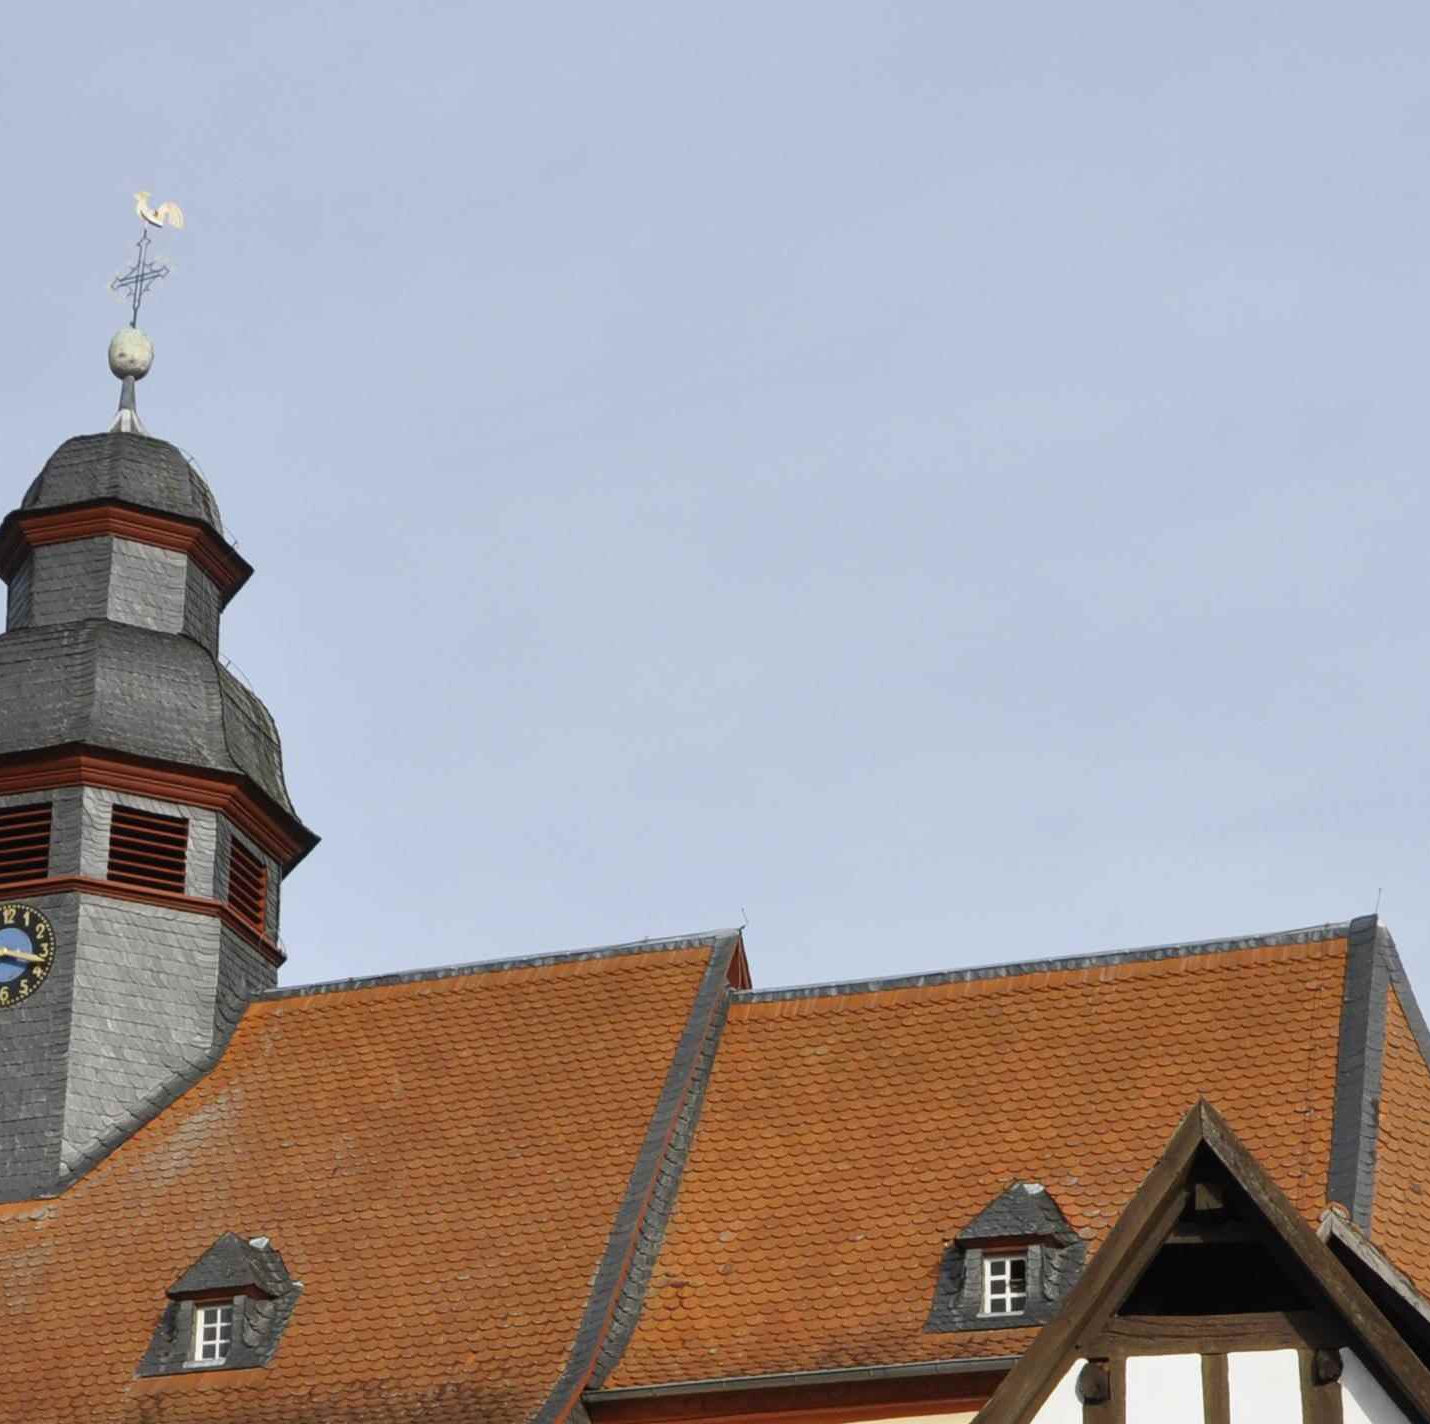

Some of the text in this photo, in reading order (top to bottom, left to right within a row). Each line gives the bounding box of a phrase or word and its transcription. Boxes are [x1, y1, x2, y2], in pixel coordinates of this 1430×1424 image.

[3, 908, 16, 924] 12
[23, 911, 30, 927] 1
[35, 923, 45, 939] 2
[39, 943, 49, 957] 3
[32, 966, 43, 978] 4
[0, 986, 9, 1001] 6
[19, 979, 28, 996] 5
